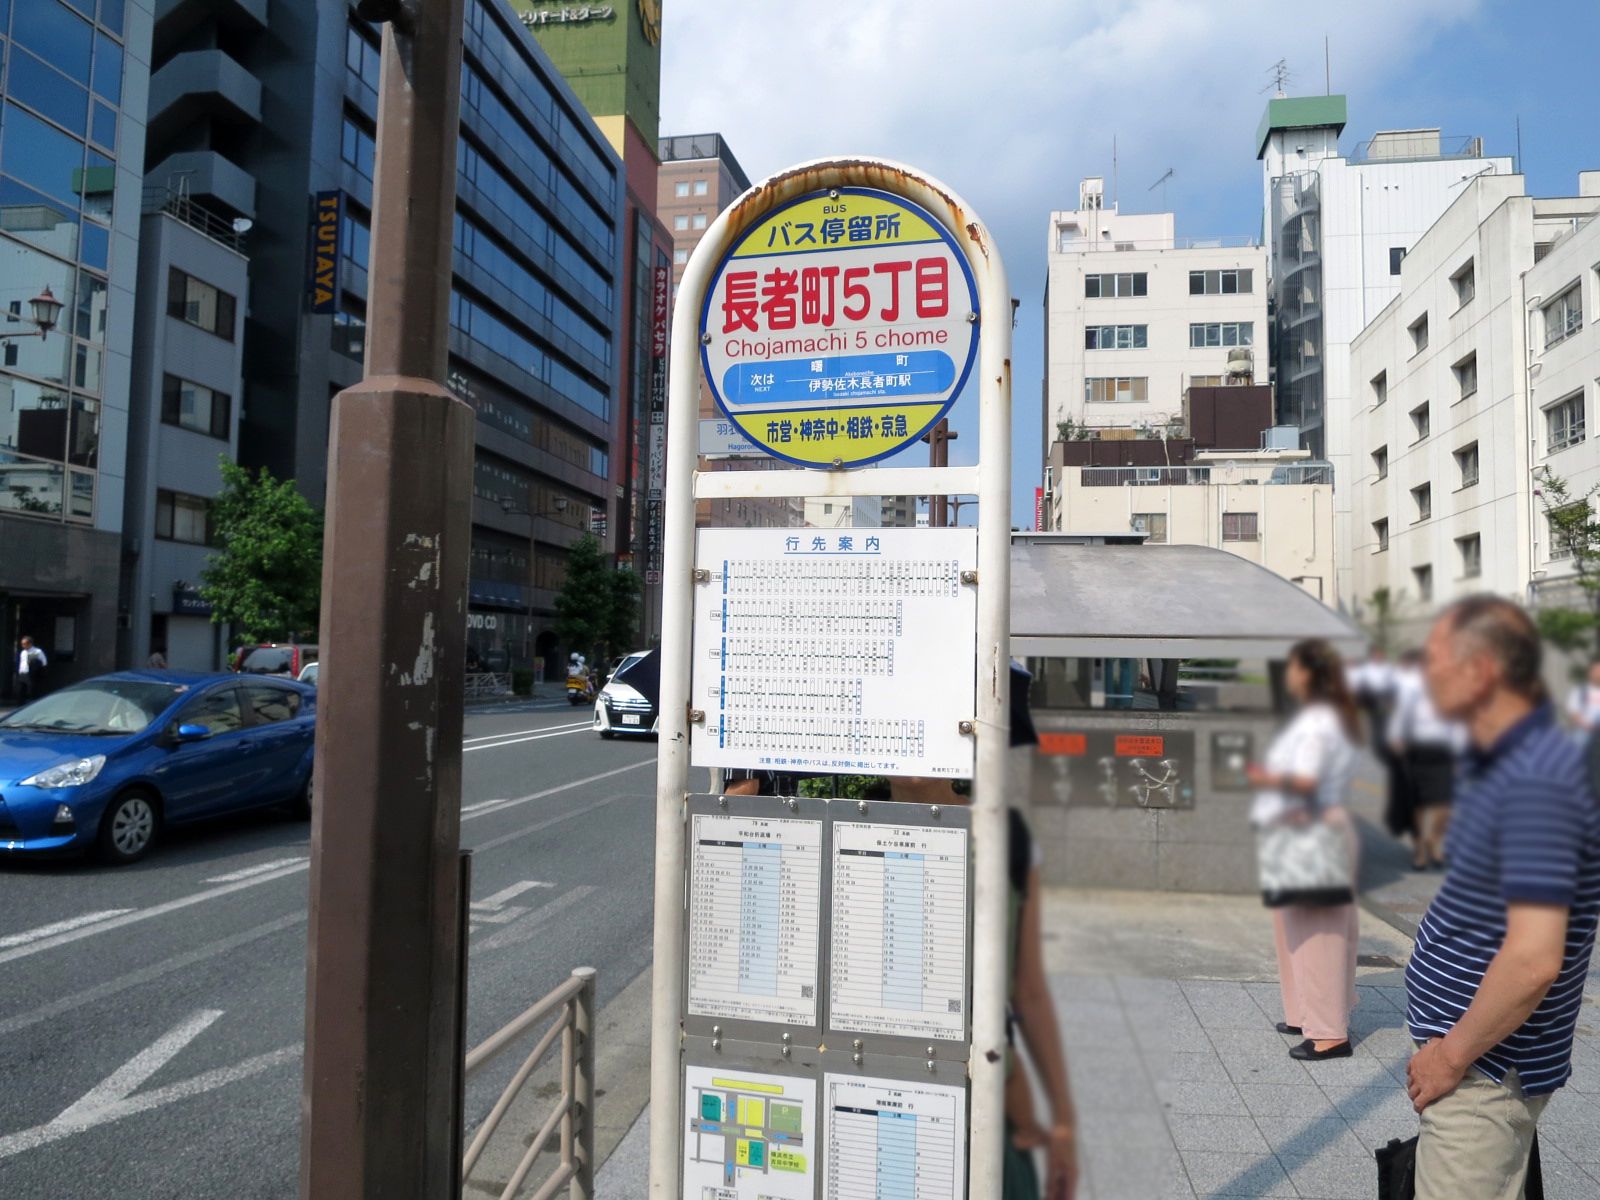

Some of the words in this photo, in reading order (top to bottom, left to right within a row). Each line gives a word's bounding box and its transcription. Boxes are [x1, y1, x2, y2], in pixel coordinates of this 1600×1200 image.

[823, 204, 847, 214] BUS
[768, 212, 900, 247] バス停留所
[315, 197, 337, 305] TSUTAYA
[722, 256, 949, 334] 長者町5丁目
[725, 332, 847, 359] Chojamachi
[855, 331, 867, 349] 5
[875, 329, 948, 348] chome
[751, 374, 775, 386] 次は
[809, 374, 911, 392] 伊勢佐木長者町駅
[786, 536, 880, 551] 行先案内
